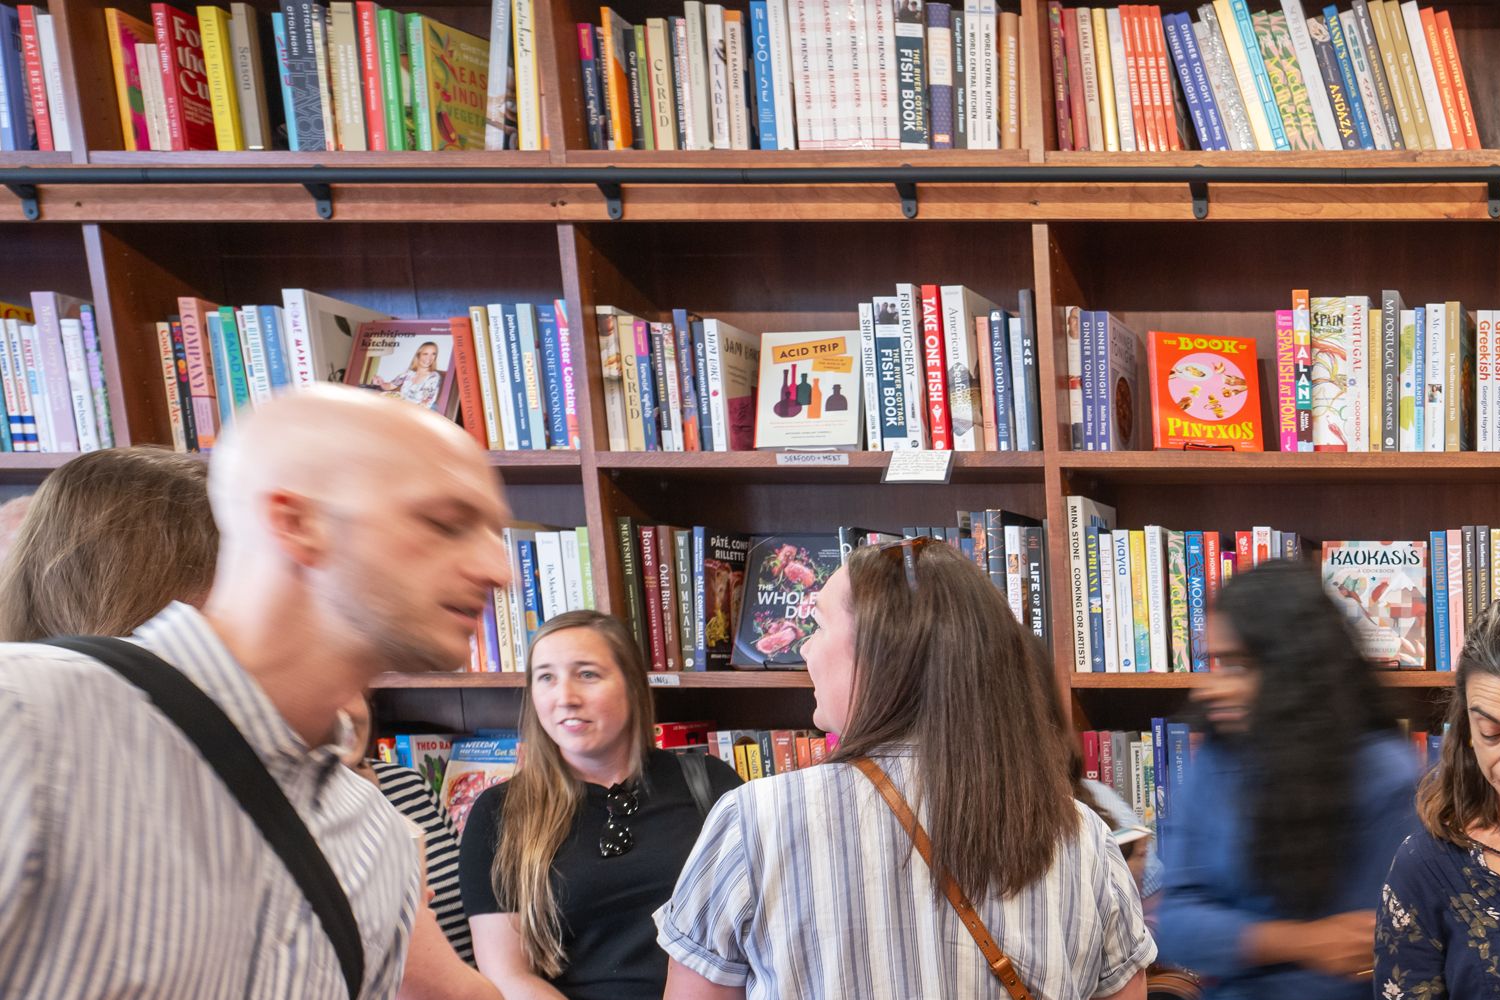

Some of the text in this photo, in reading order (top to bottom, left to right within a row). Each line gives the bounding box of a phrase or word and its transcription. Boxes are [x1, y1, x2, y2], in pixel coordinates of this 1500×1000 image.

[24, 34, 45, 115] EAT BETTER
[755, 7, 769, 102] NIÇOISE
[1181, 24, 1211, 103] DINNER TONIGHT
[654, 59, 669, 127] CURED
[900, 48, 916, 131] FISH BOOK
[914, 95, 924, 131] COTTAGE
[1329, 84, 1352, 138] ANDAZA
[182, 312, 207, 389] COMPANY
[780, 342, 840, 359] ACID TRIP
[902, 320, 915, 377] BUTCHERY
[923, 297, 943, 402] TAKE ONE FISH
[1023, 339, 1033, 366] HAM
[1177, 337, 1239, 354] BOOK
[1385, 299, 1395, 369] MY PORTUGAL
[1479, 321, 1491, 381] Greekish
[559, 327, 577, 415] Better Cooking
[1278, 329, 1296, 433] SPANISH AT HOME
[1167, 417, 1254, 440] PINTXOS
[641, 530, 654, 567] Bones
[1331, 549, 1421, 566] KAUKASIS
[677, 535, 692, 639] WILD MEAT
[1073, 568, 1083, 612] COOKING
[1192, 577, 1205, 633] MOORISH
[1077, 631, 1086, 666] ARTISTS
